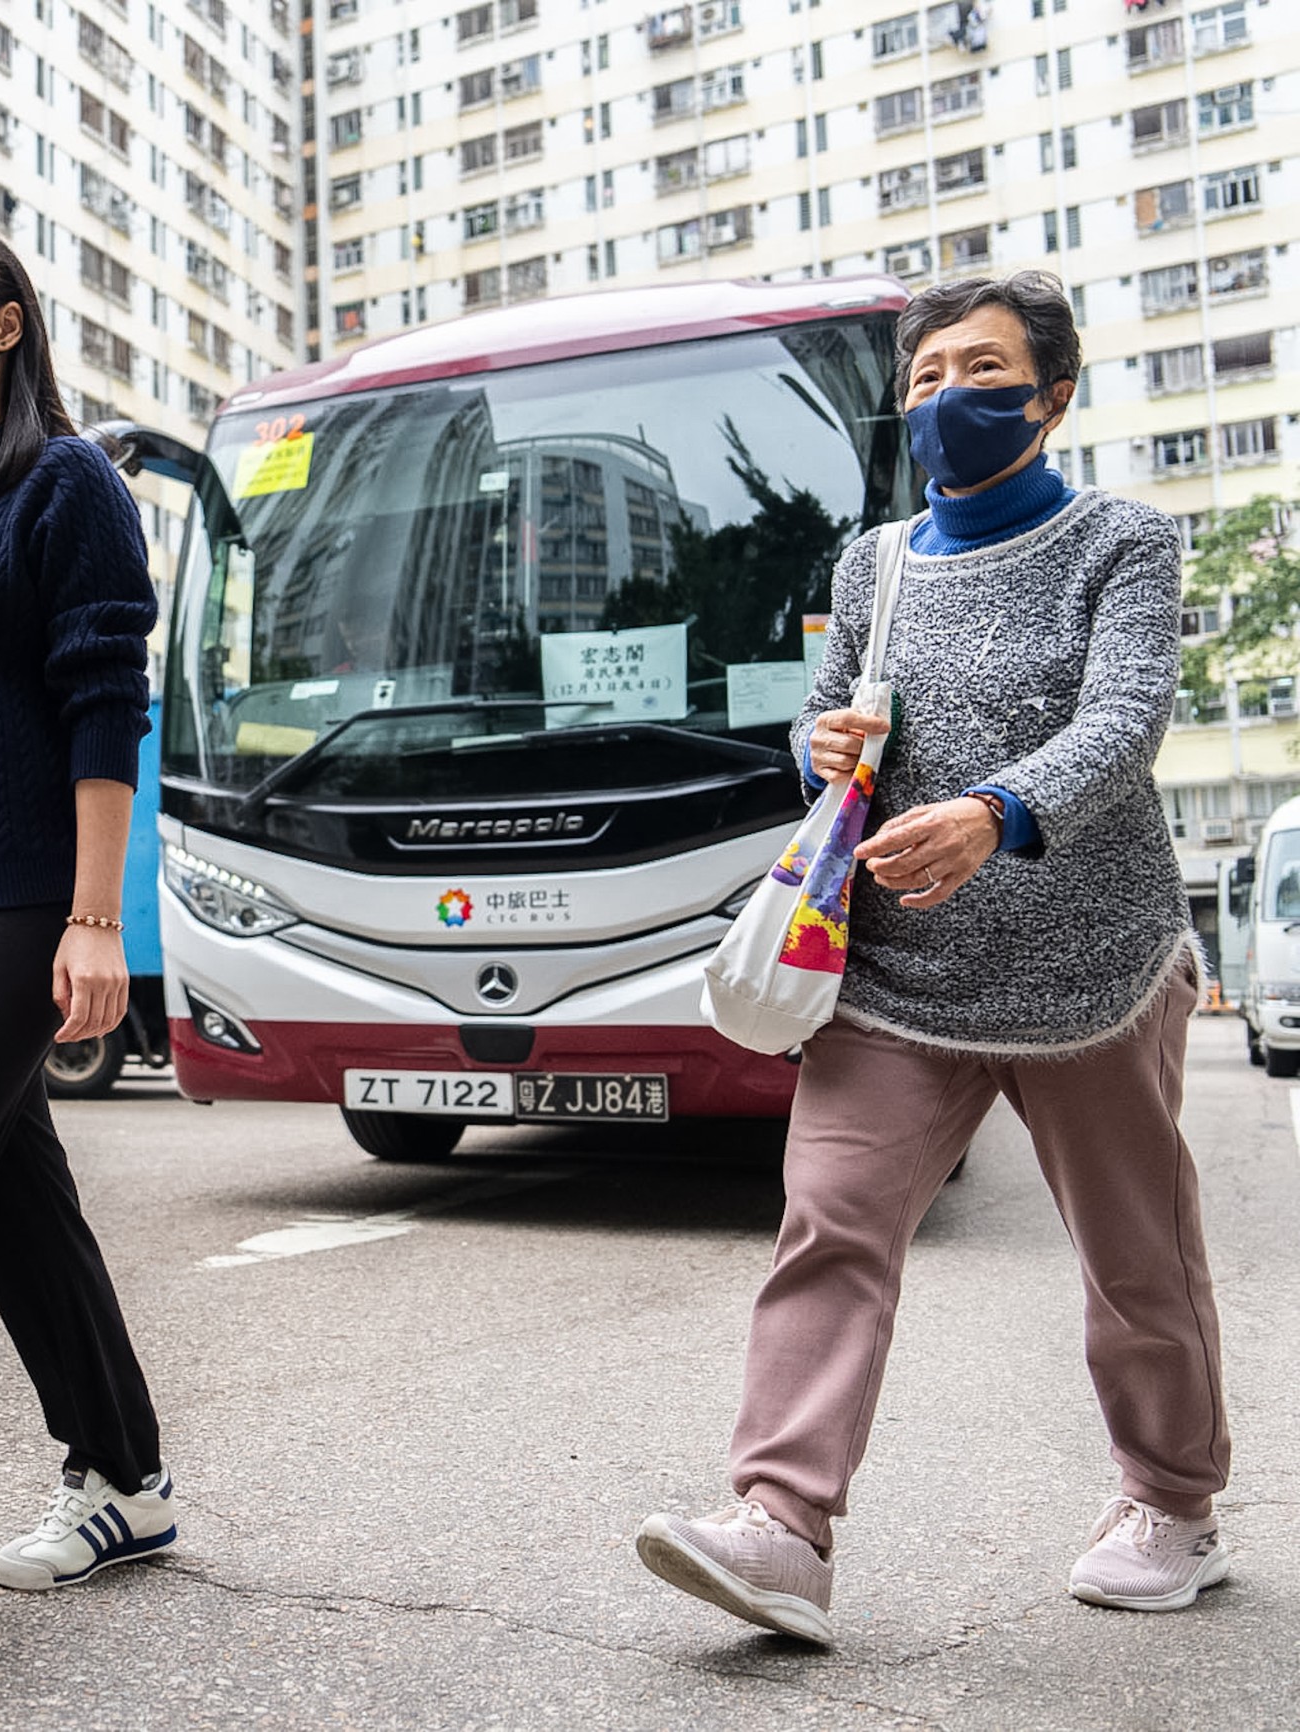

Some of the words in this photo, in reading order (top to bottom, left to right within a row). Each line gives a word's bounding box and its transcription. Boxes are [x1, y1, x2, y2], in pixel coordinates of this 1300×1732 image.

[254, 413, 306, 446] 302
[407, 812, 584, 838] Marcopolo
[486, 889, 570, 910] 中旅巴士
[530, 912, 571, 922] BUS
[359, 1076, 400, 1105] ZT
[416, 1078, 498, 1107] 7122
